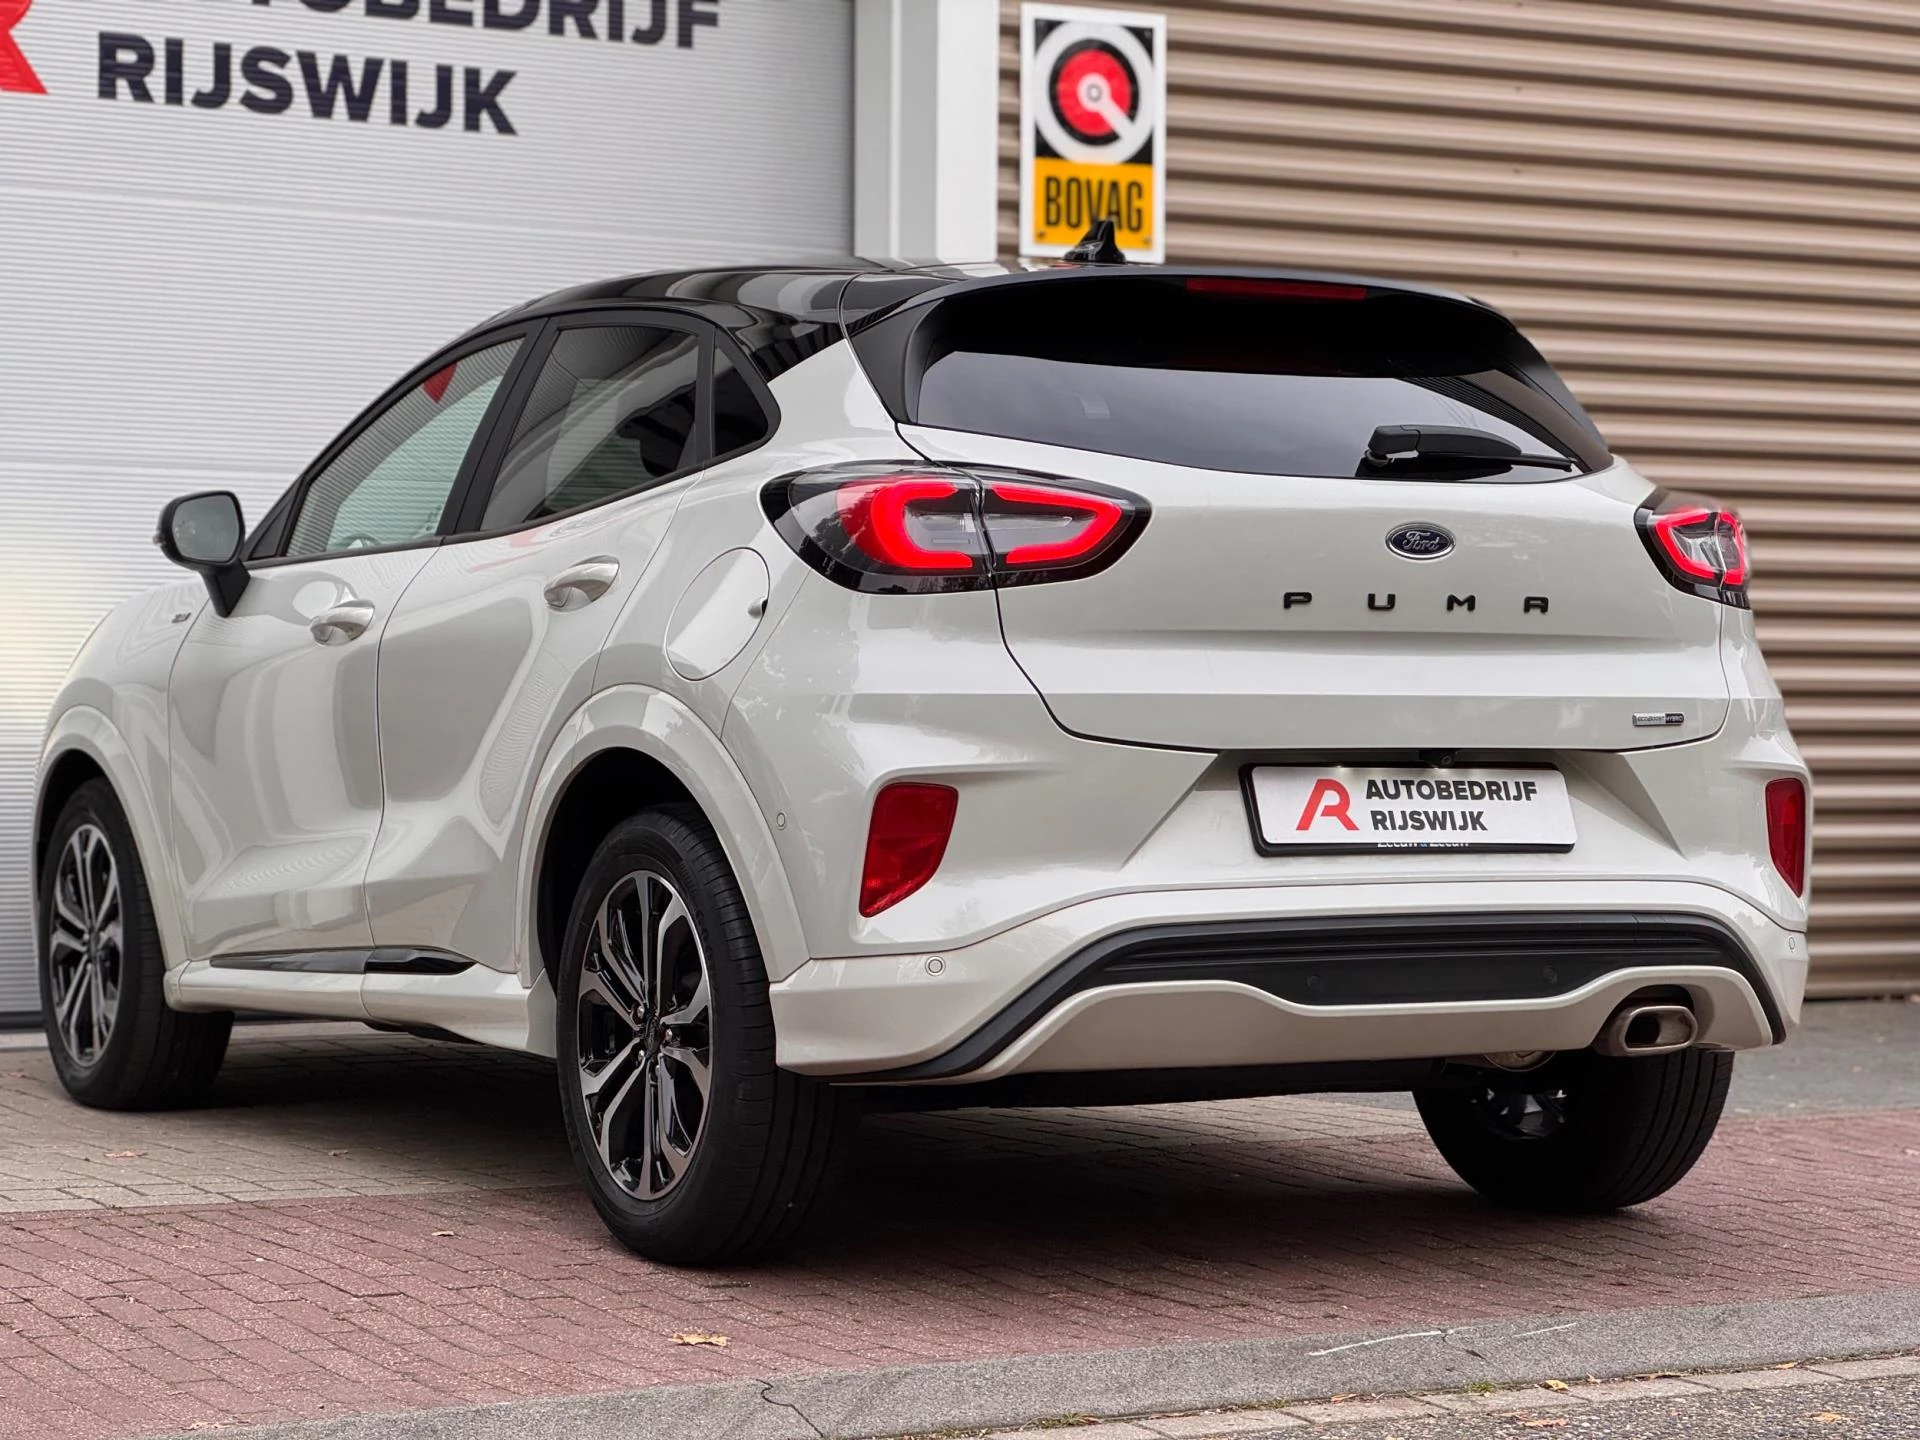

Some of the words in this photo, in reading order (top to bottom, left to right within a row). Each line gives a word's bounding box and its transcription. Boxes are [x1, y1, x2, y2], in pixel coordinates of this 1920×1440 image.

[98, 31, 518, 136] RIJSWIJK
[1045, 176, 1143, 232] BOVAG
[1402, 531, 1440, 550] Ford
[1283, 591, 1549, 614] PUMA
[1366, 779, 1538, 801] AUTOBEDRIJF
[1370, 810, 1488, 831] RIJSWIJK
